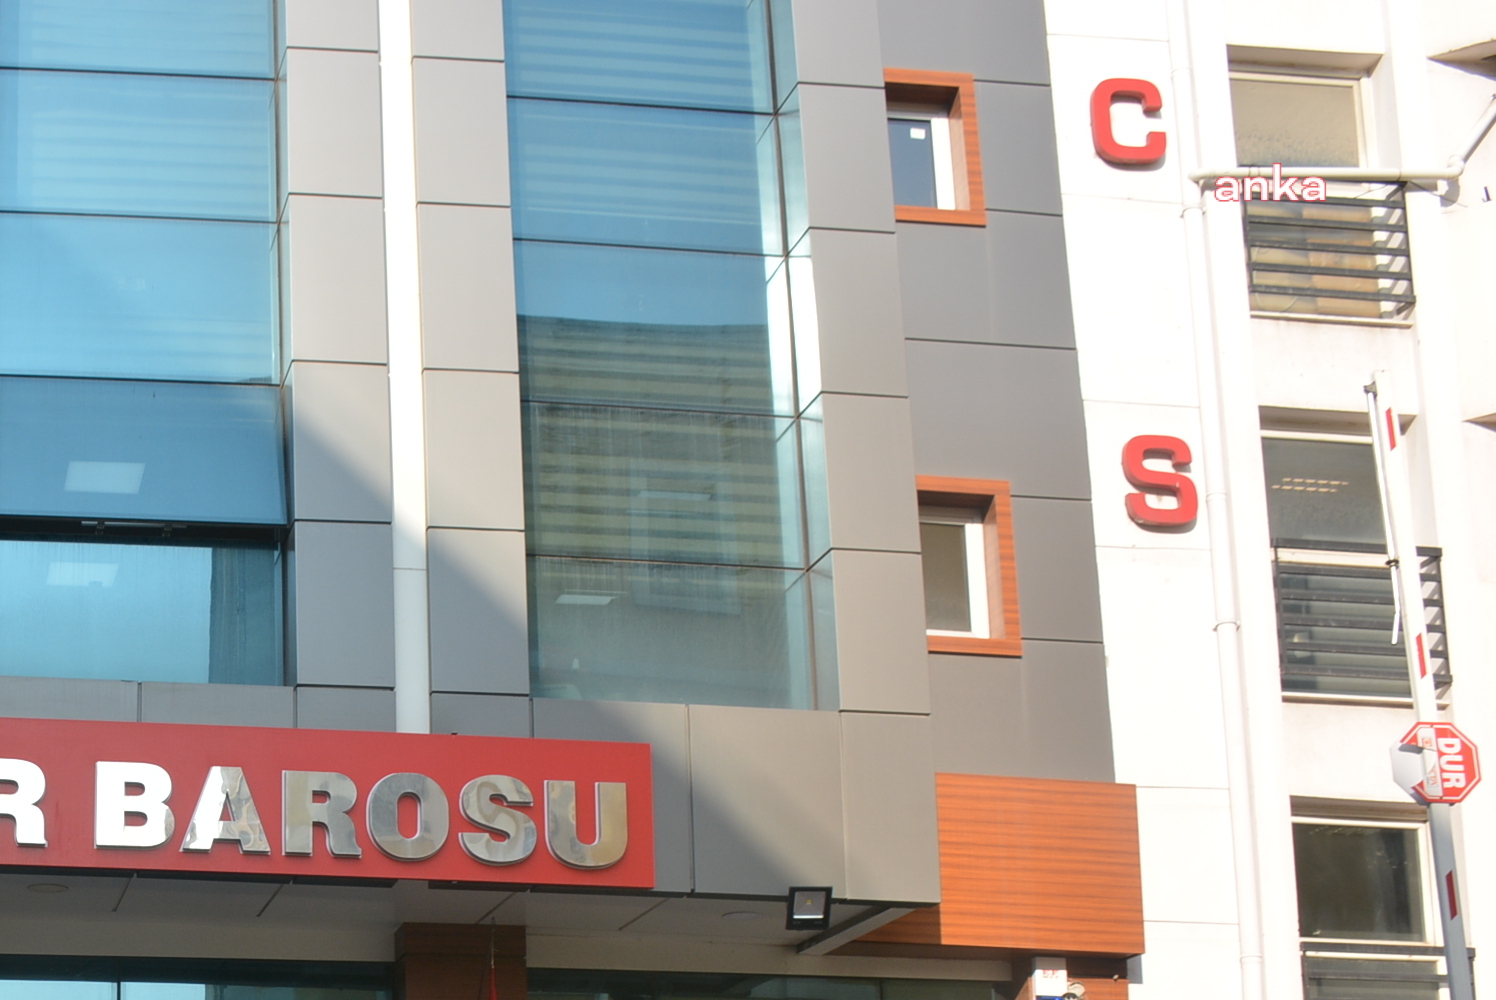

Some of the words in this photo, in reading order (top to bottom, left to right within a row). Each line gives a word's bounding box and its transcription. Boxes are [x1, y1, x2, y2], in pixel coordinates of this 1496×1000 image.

[1090, 78, 1167, 166] C
[1122, 434, 1198, 527] S
[1437, 737, 1466, 789] DUR
[94, 760, 628, 871] BAROSU
